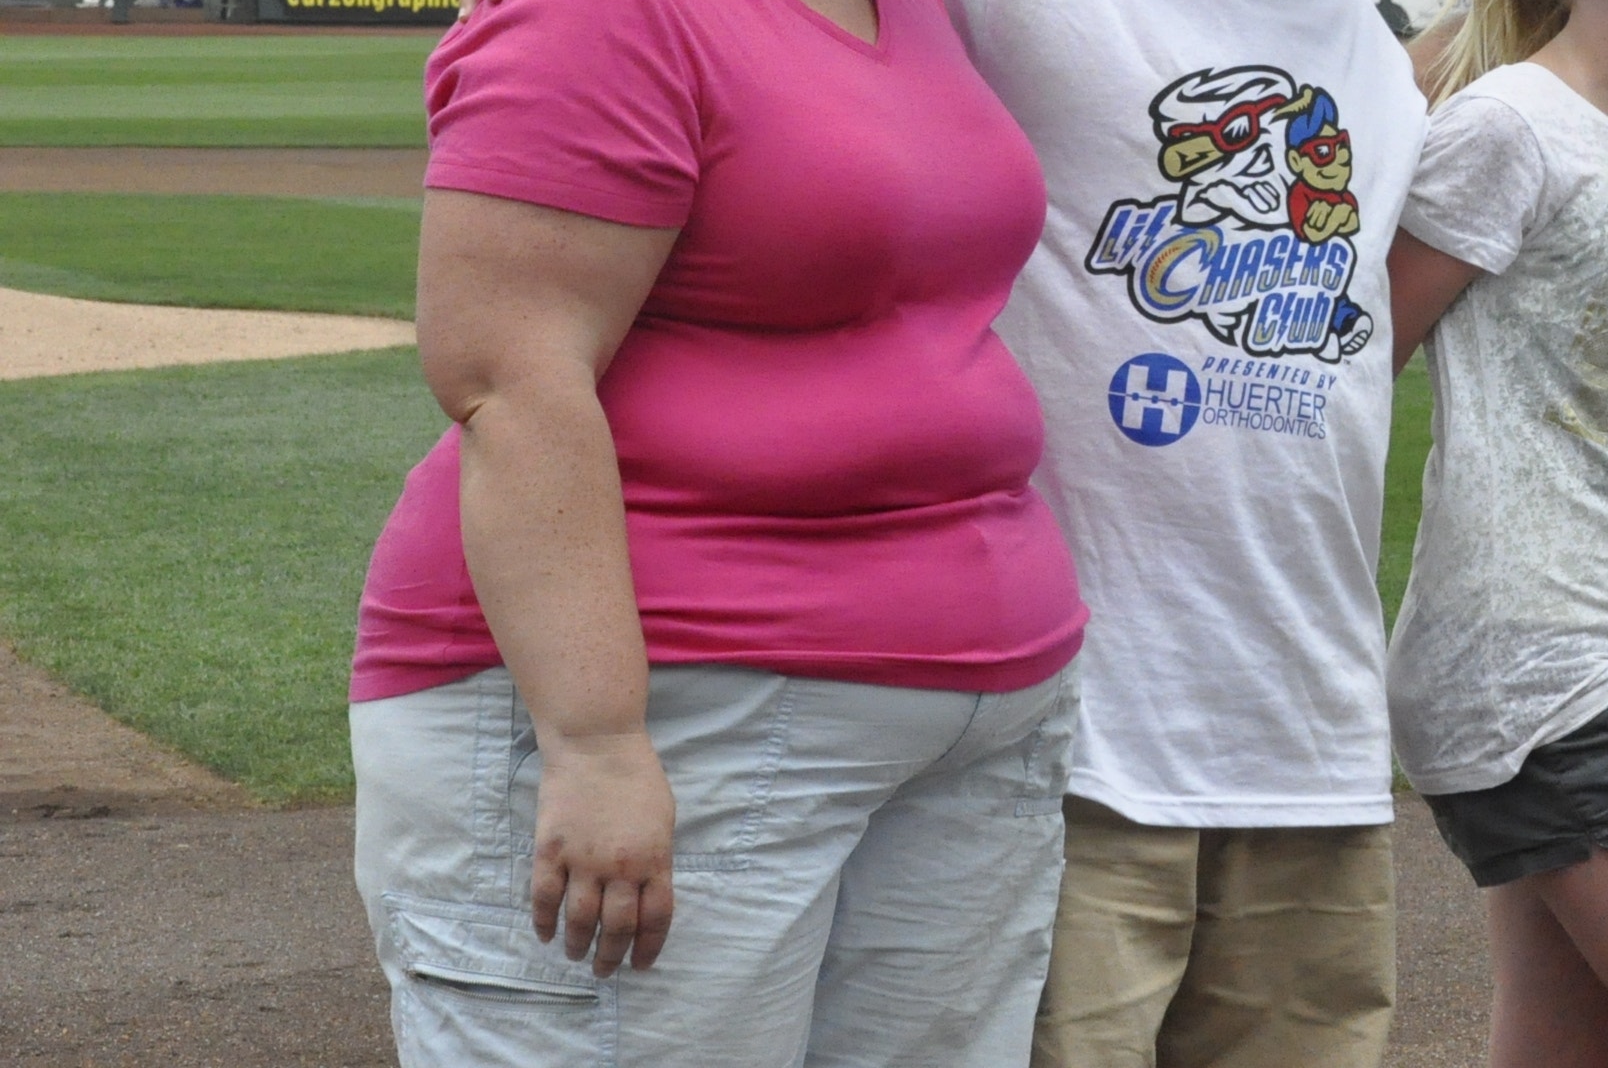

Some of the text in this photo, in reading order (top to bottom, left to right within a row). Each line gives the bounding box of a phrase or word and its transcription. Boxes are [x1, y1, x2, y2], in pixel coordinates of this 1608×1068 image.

[1140, 226, 1348, 311] CHASERS
[1202, 356, 1337, 391] PRESENTED BY
[1205, 378, 1327, 422] HUERTER
[1203, 406, 1327, 440] ORTHODONTICS
